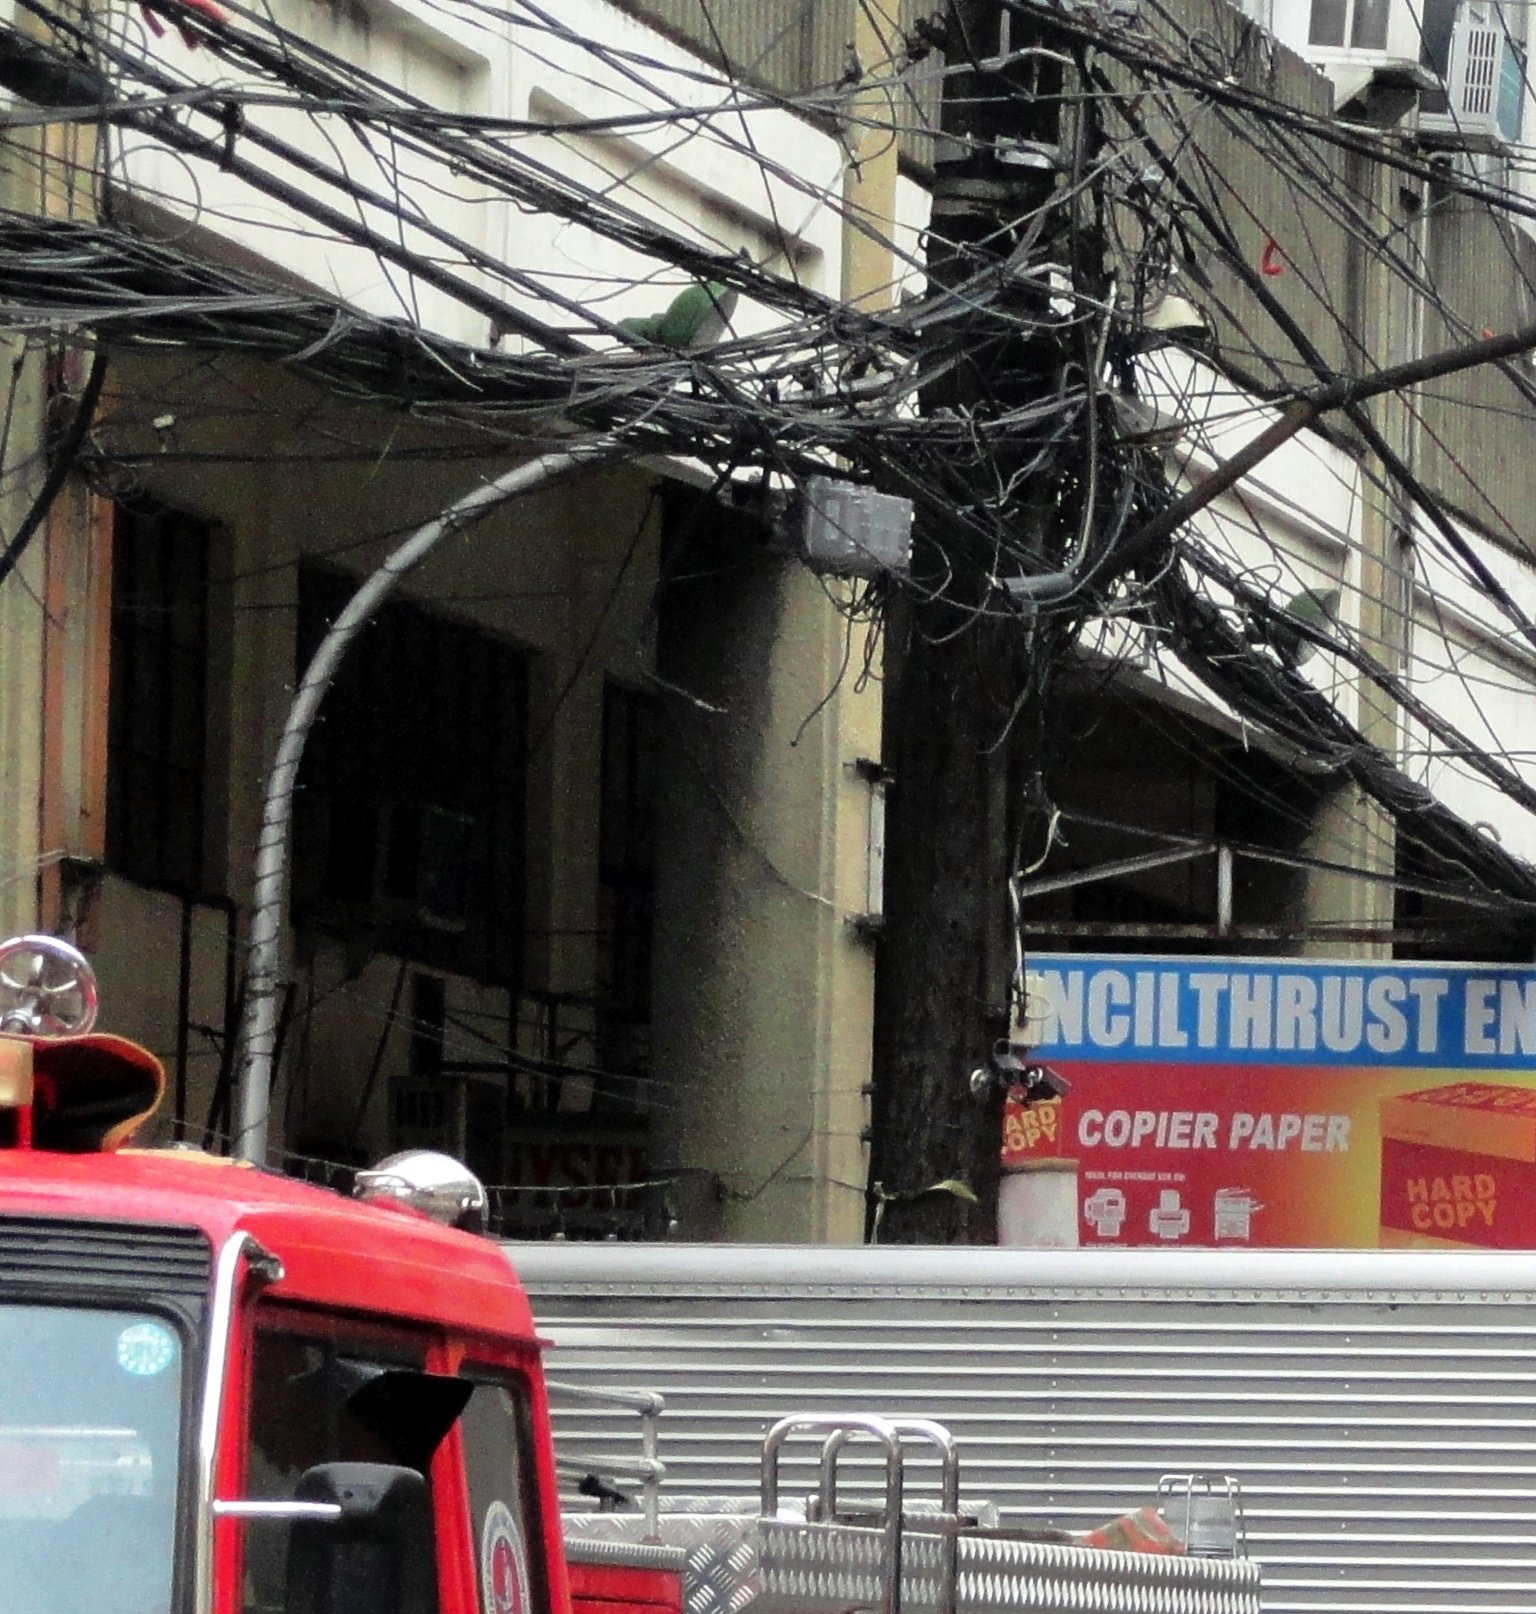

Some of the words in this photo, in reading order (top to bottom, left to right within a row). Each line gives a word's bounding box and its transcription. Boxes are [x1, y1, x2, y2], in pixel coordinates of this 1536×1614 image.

[1196, 972, 1450, 1057] THRUST
[1001, 1123, 1057, 1155] OPY
[1078, 1109, 1218, 1149] COPIER
[1229, 1112, 1350, 1151] PAPER
[1407, 1174, 1496, 1204] HARD
[1411, 1200, 1498, 1229] COPY
